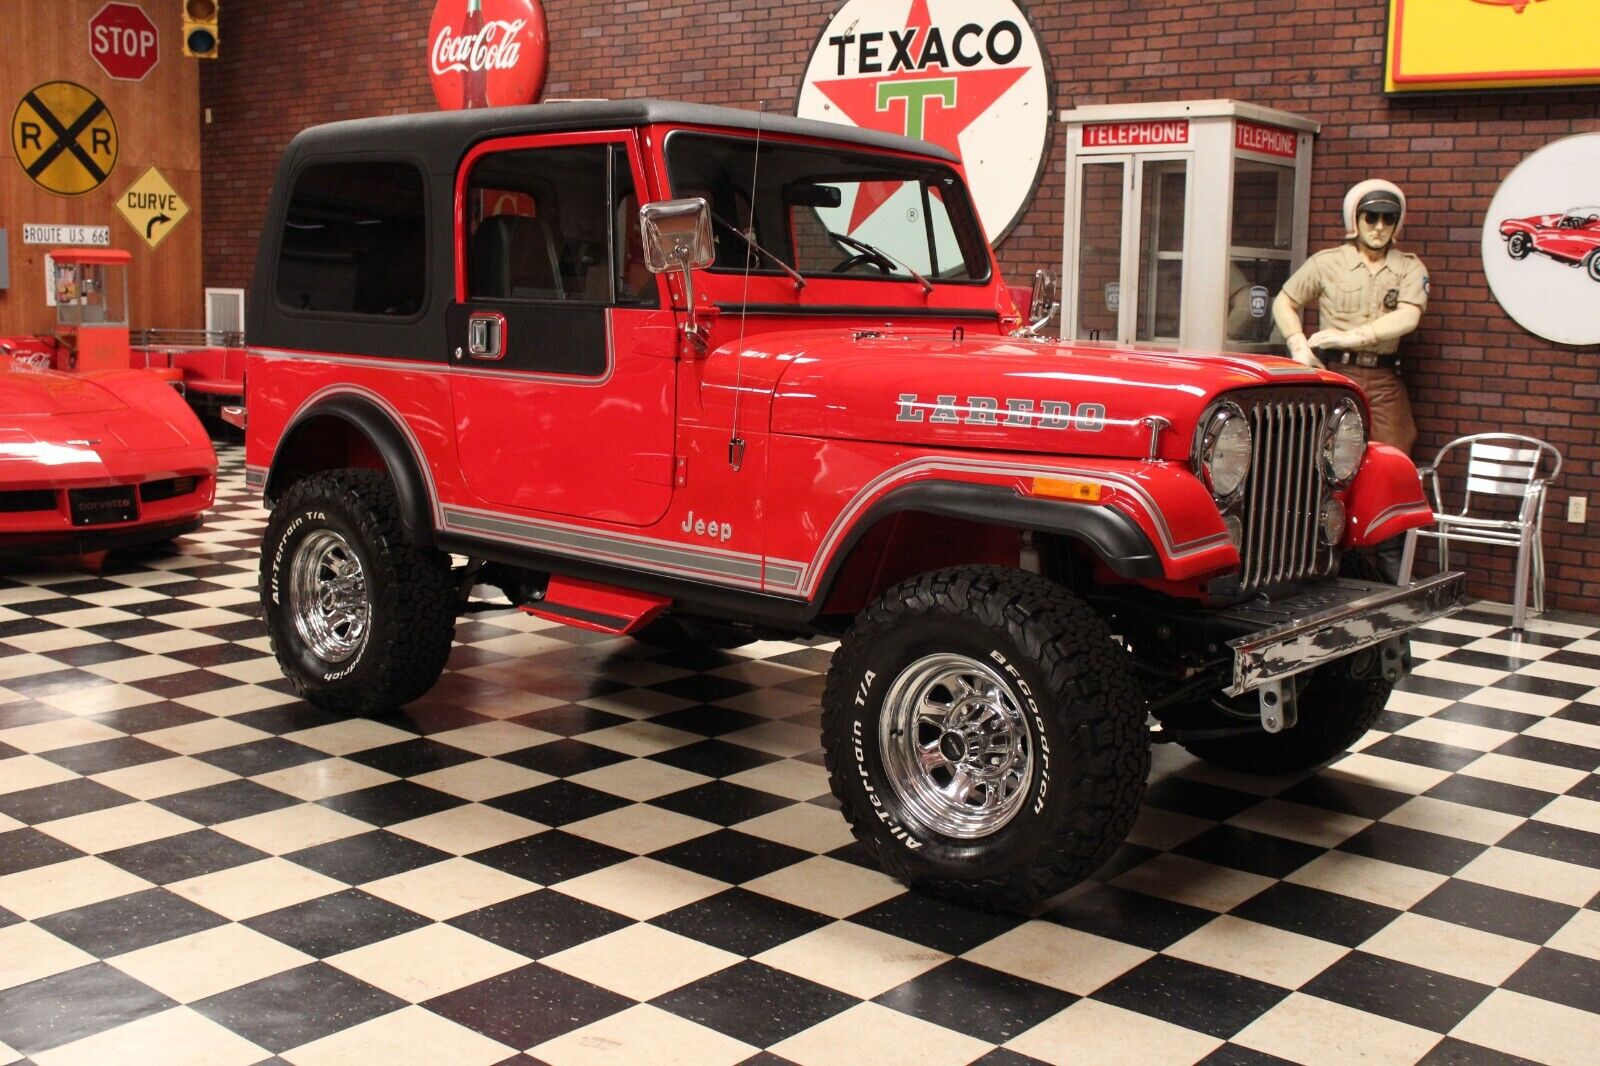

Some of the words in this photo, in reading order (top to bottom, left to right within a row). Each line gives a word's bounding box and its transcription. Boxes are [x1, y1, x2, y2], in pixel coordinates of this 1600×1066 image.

[94, 25, 154, 58] STOP
[431, 18, 528, 75] Coca-Cola
[829, 20, 1023, 76] TEXACO
[1087, 121, 1187, 145] TELEPHONE
[1236, 124, 1295, 154] TELEPHONE
[127, 192, 177, 211] CURVE
[29, 227, 62, 242] ROUTE
[91, 229, 104, 243] 66
[896, 393, 1106, 432] LAREDO
[681, 510, 732, 542] Jeep
[271, 517, 303, 606] All-Terrain
[305, 510, 326, 521] T/A
[854, 669, 877, 708] T/A
[989, 649, 1050, 815] BFGoodrich
[852, 719, 923, 850] All-Terrain
